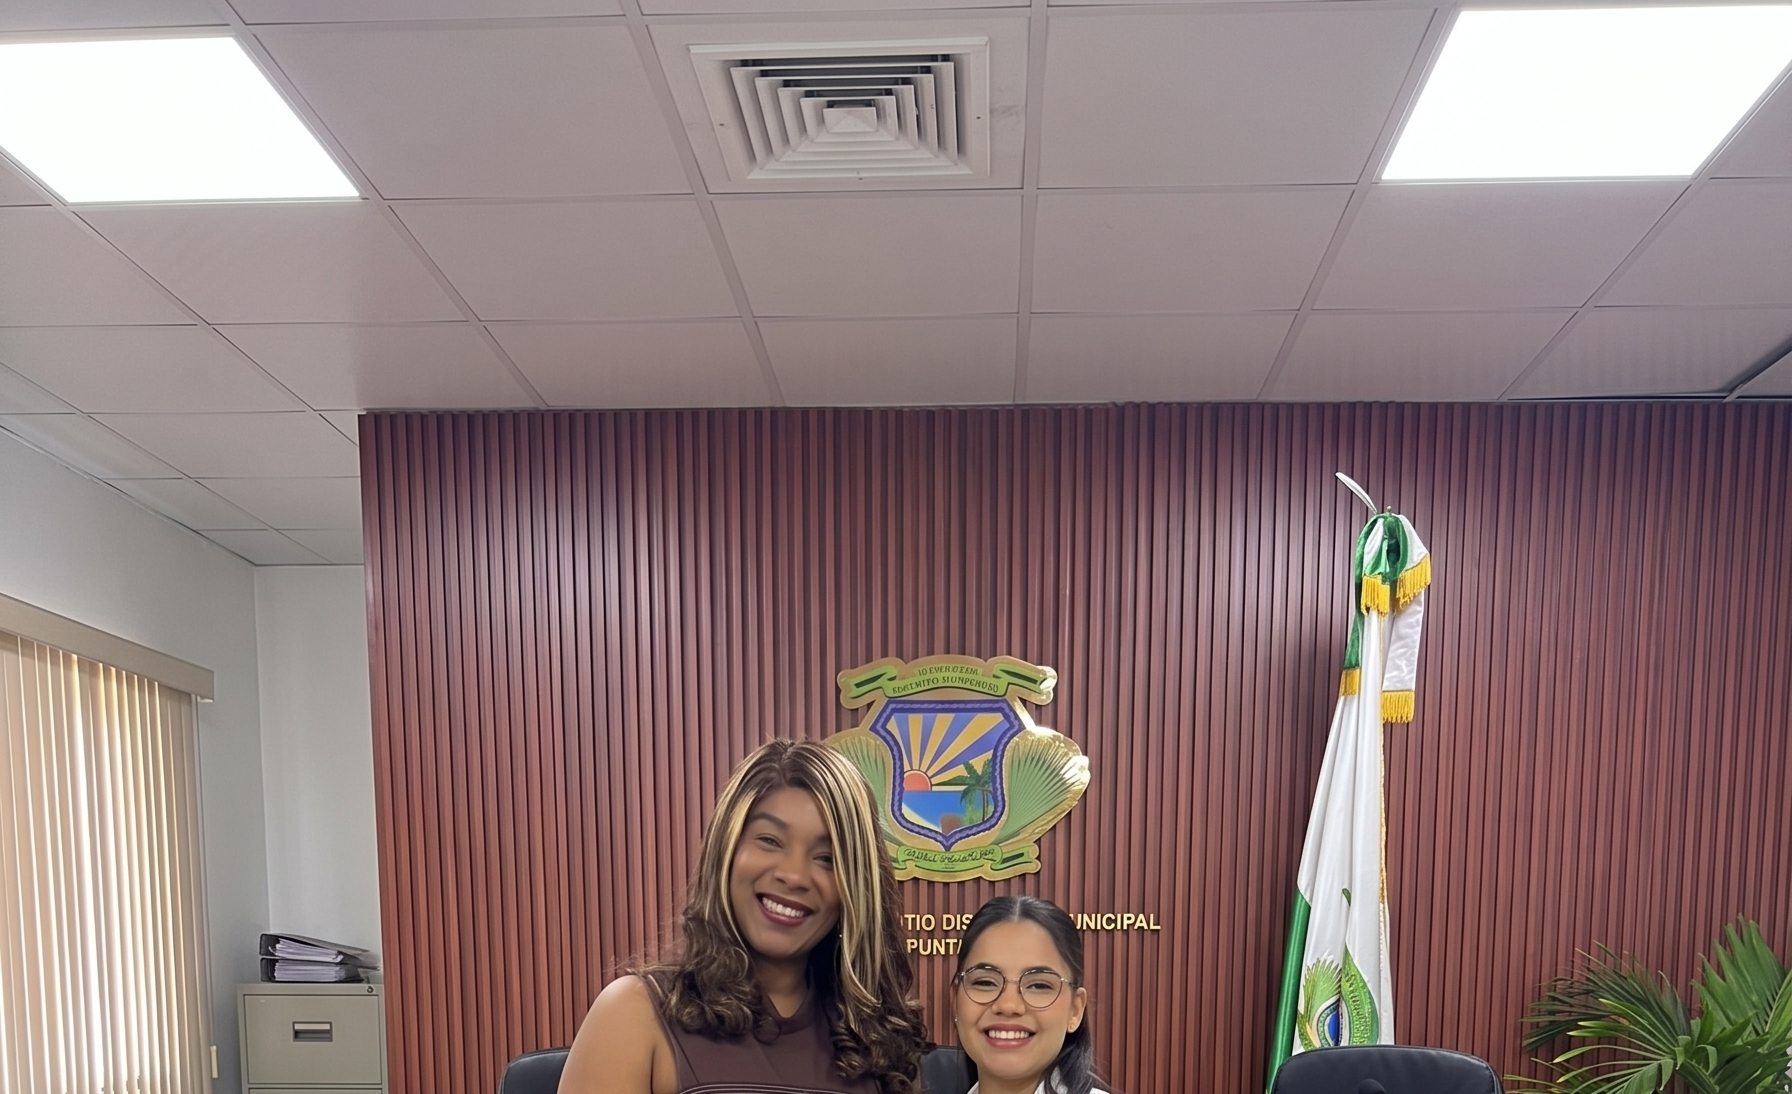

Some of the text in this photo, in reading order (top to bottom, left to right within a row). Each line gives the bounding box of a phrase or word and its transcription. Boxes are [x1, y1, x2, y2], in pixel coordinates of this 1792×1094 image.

[901, 913, 1161, 931] TIO DIS UNICIPAL
[906, 938, 962, 955] PUNT
